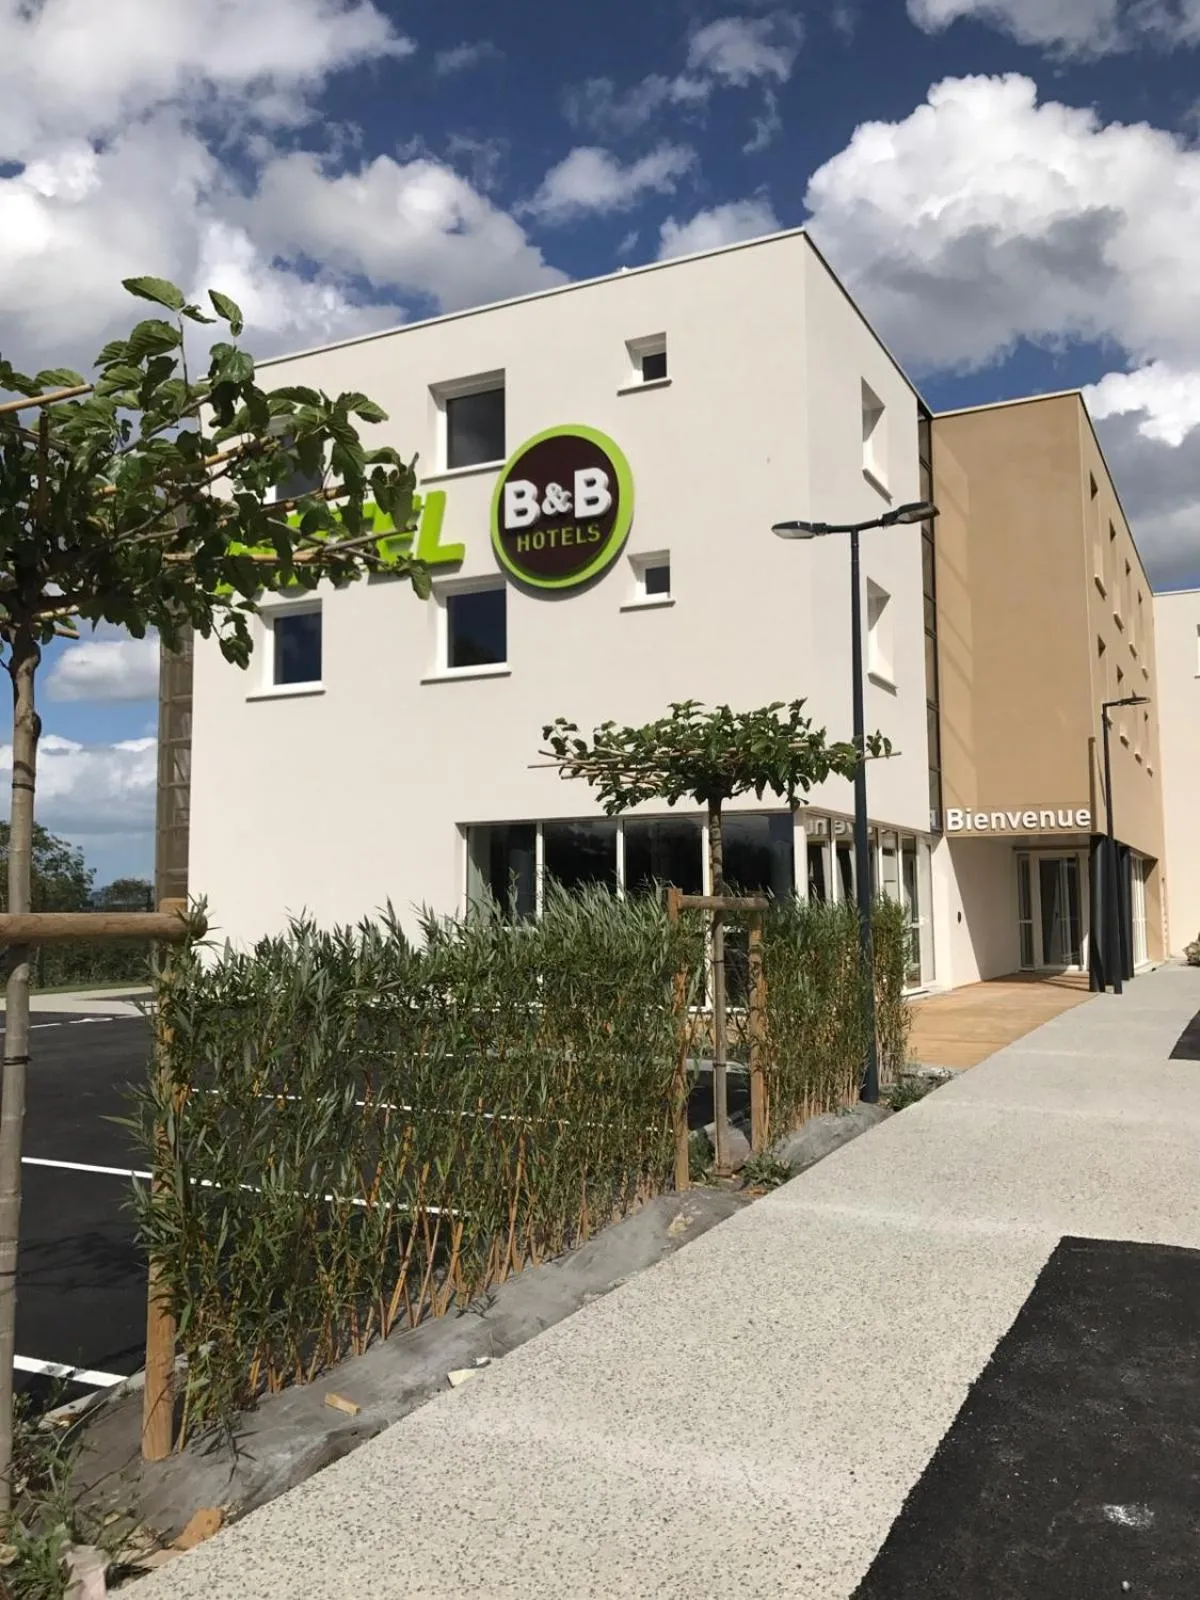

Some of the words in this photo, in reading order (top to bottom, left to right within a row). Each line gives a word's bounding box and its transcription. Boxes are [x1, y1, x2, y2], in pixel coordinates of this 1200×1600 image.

[504, 467, 613, 530] B&B
[516, 524, 601, 553] HOTELS
[946, 807, 1092, 832] Bienvenue
